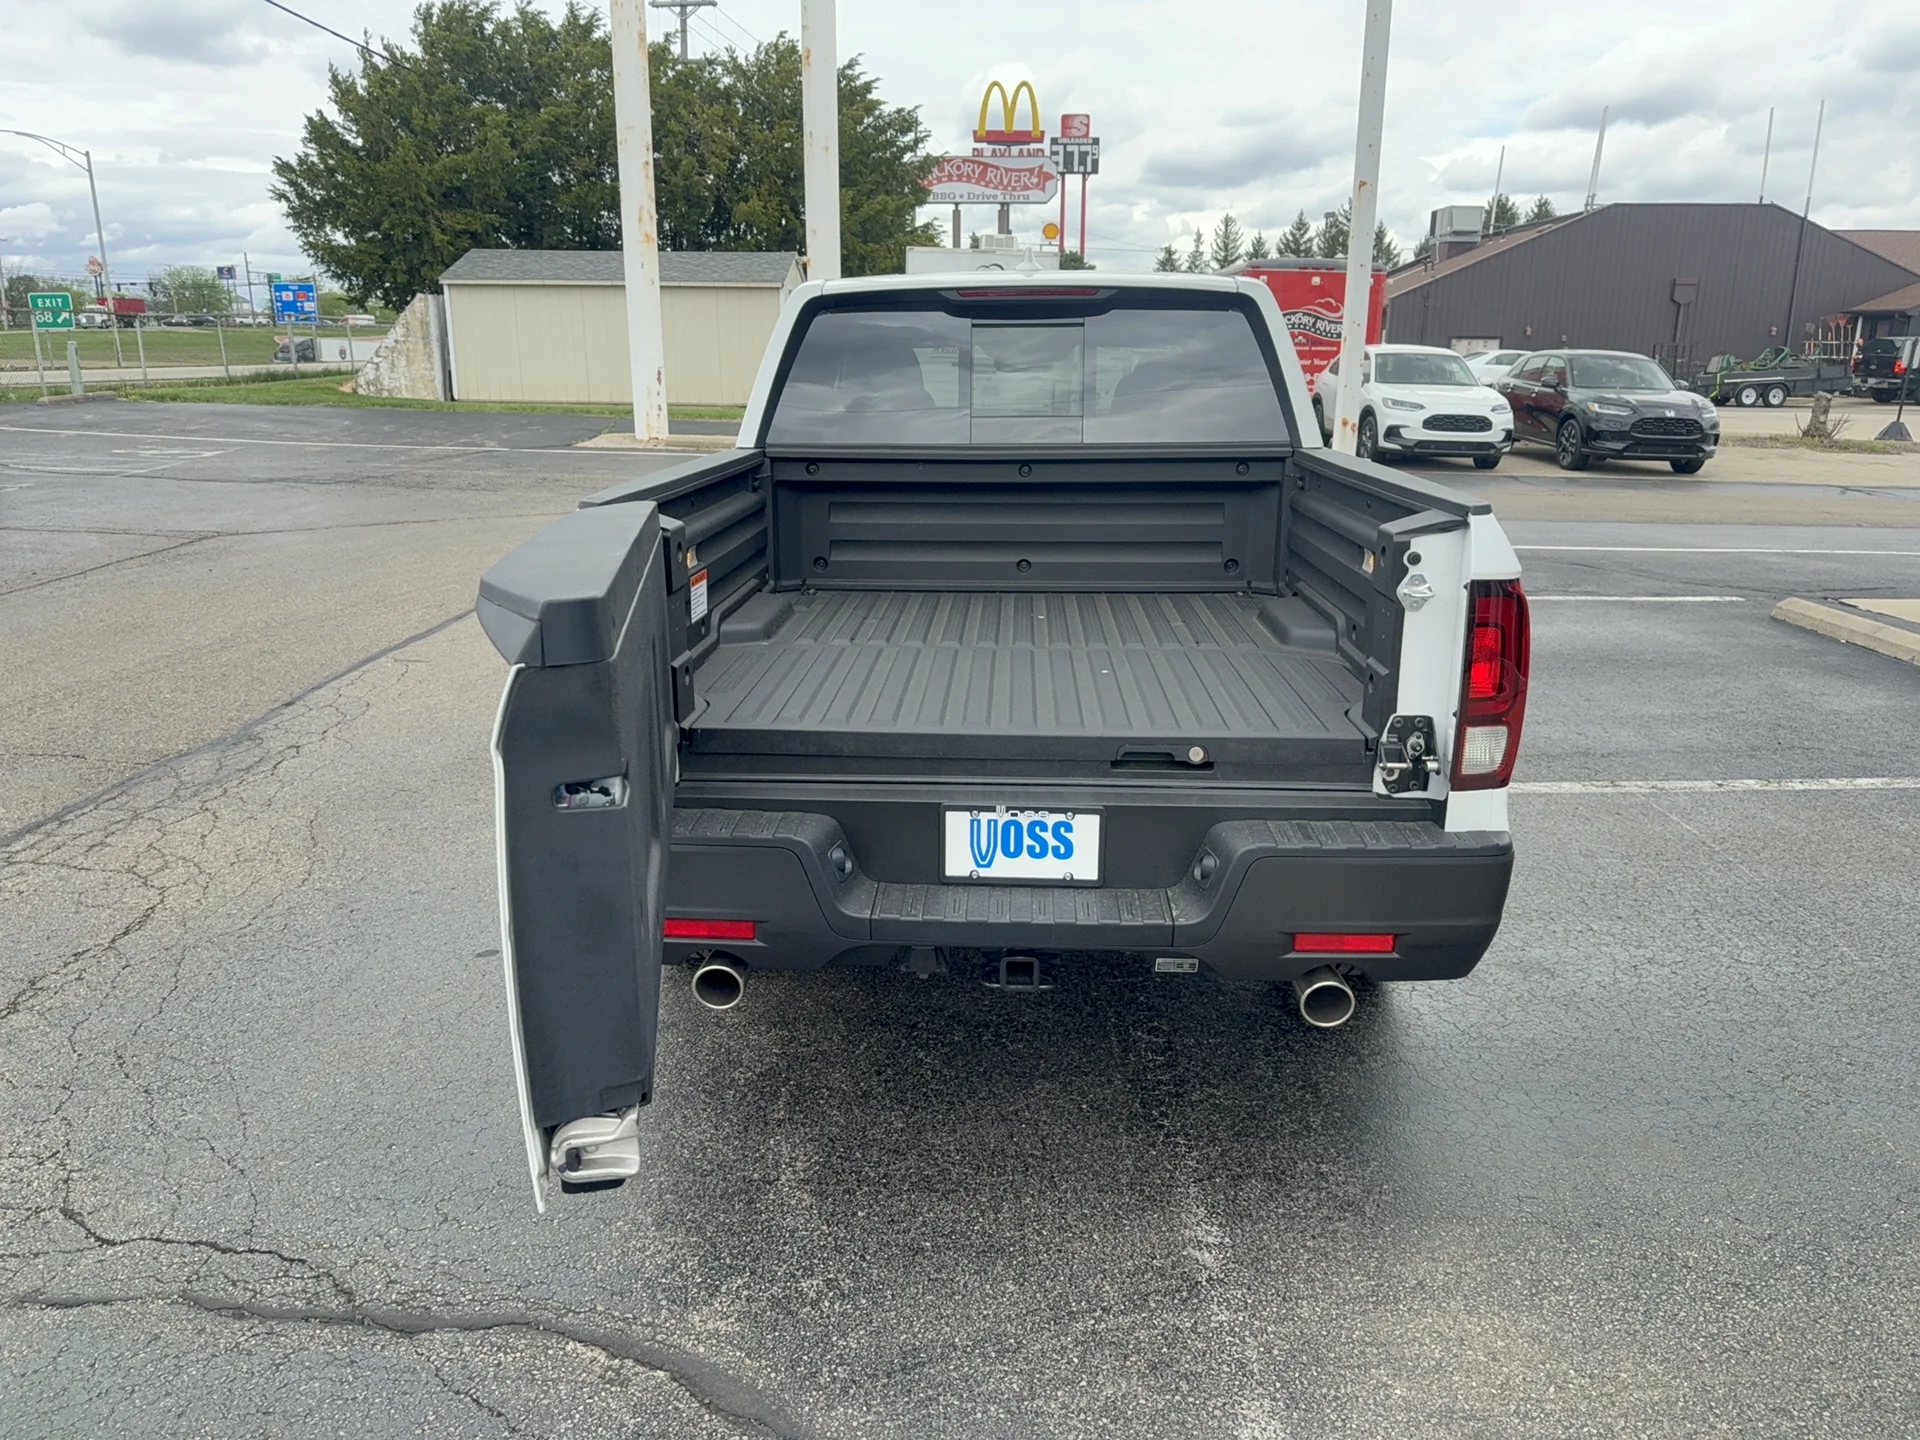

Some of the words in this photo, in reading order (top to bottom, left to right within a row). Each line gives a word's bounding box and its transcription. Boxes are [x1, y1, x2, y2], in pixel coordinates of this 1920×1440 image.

[932, 192, 957, 200] BBQ
[967, 191, 998, 200] Drive
[1001, 191, 1030, 200] Thru
[37, 298, 63, 308] EXIT
[35, 311, 53, 323] 68
[970, 818, 1074, 868] VOSS
